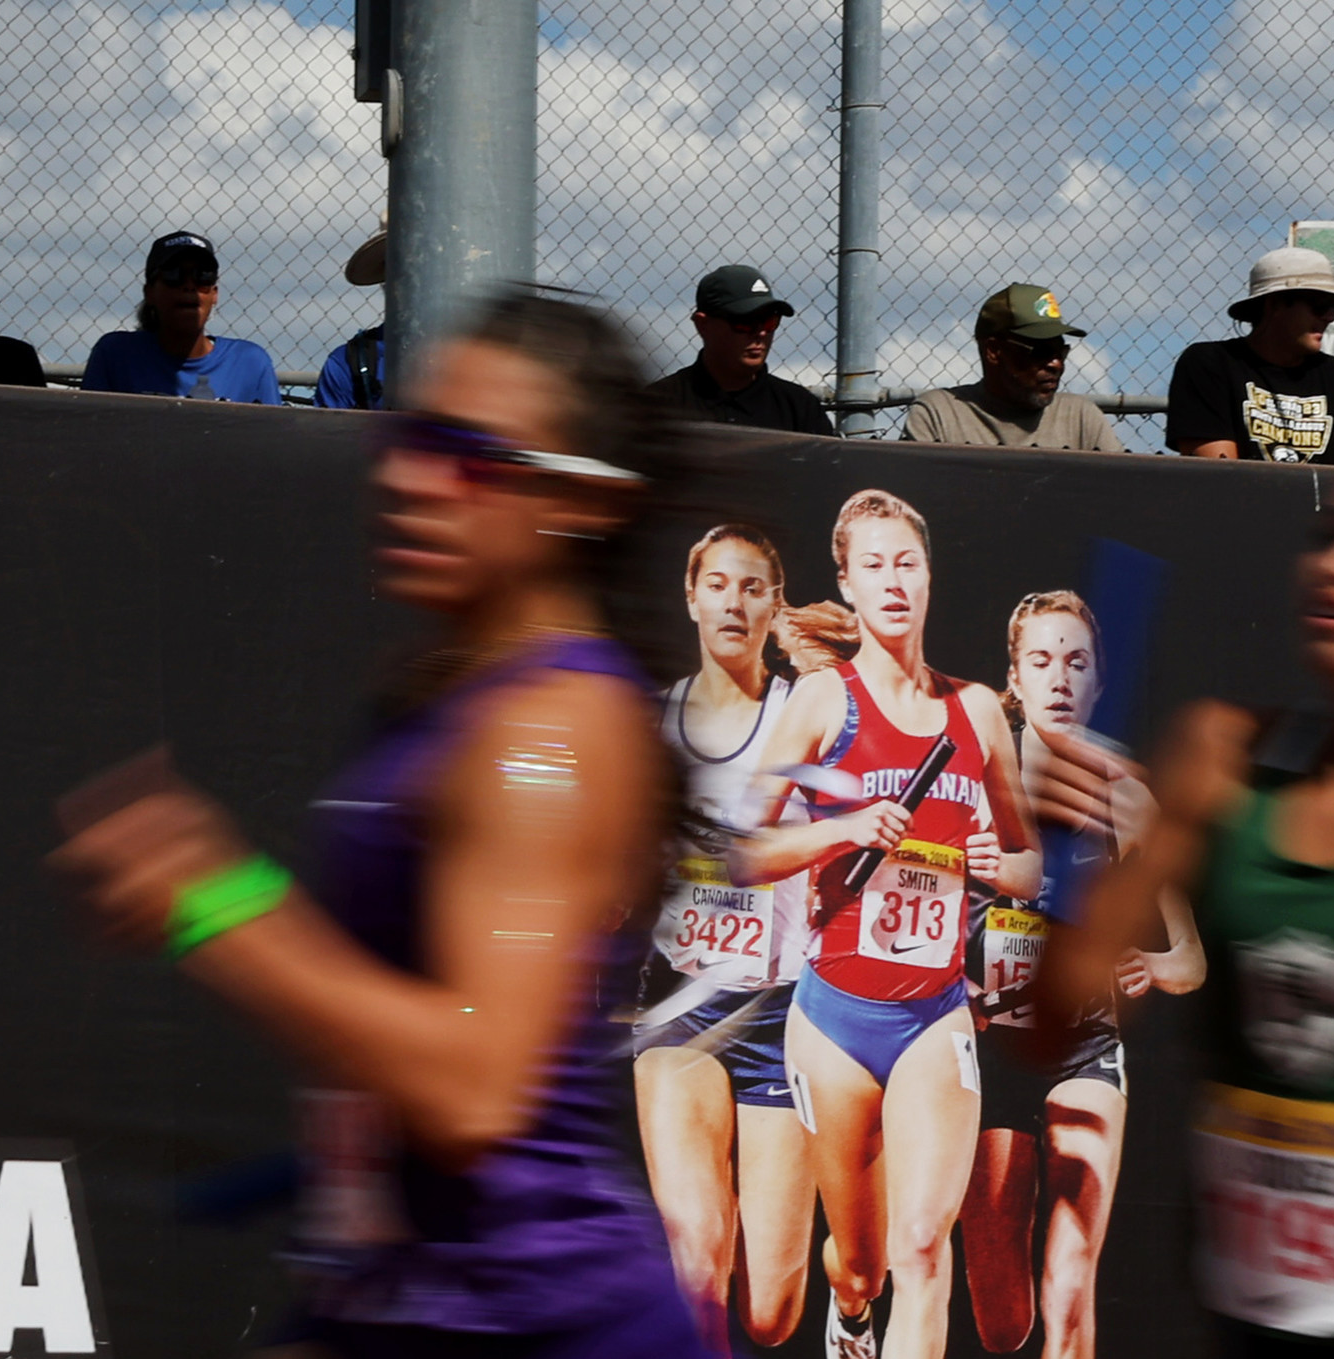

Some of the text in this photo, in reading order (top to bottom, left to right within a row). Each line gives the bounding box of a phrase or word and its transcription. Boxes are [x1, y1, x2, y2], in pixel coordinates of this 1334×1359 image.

[862, 768, 981, 809] BUCANAN
[898, 869, 938, 893] SMITH
[676, 909, 764, 958] 3422
[879, 891, 946, 941] 313
